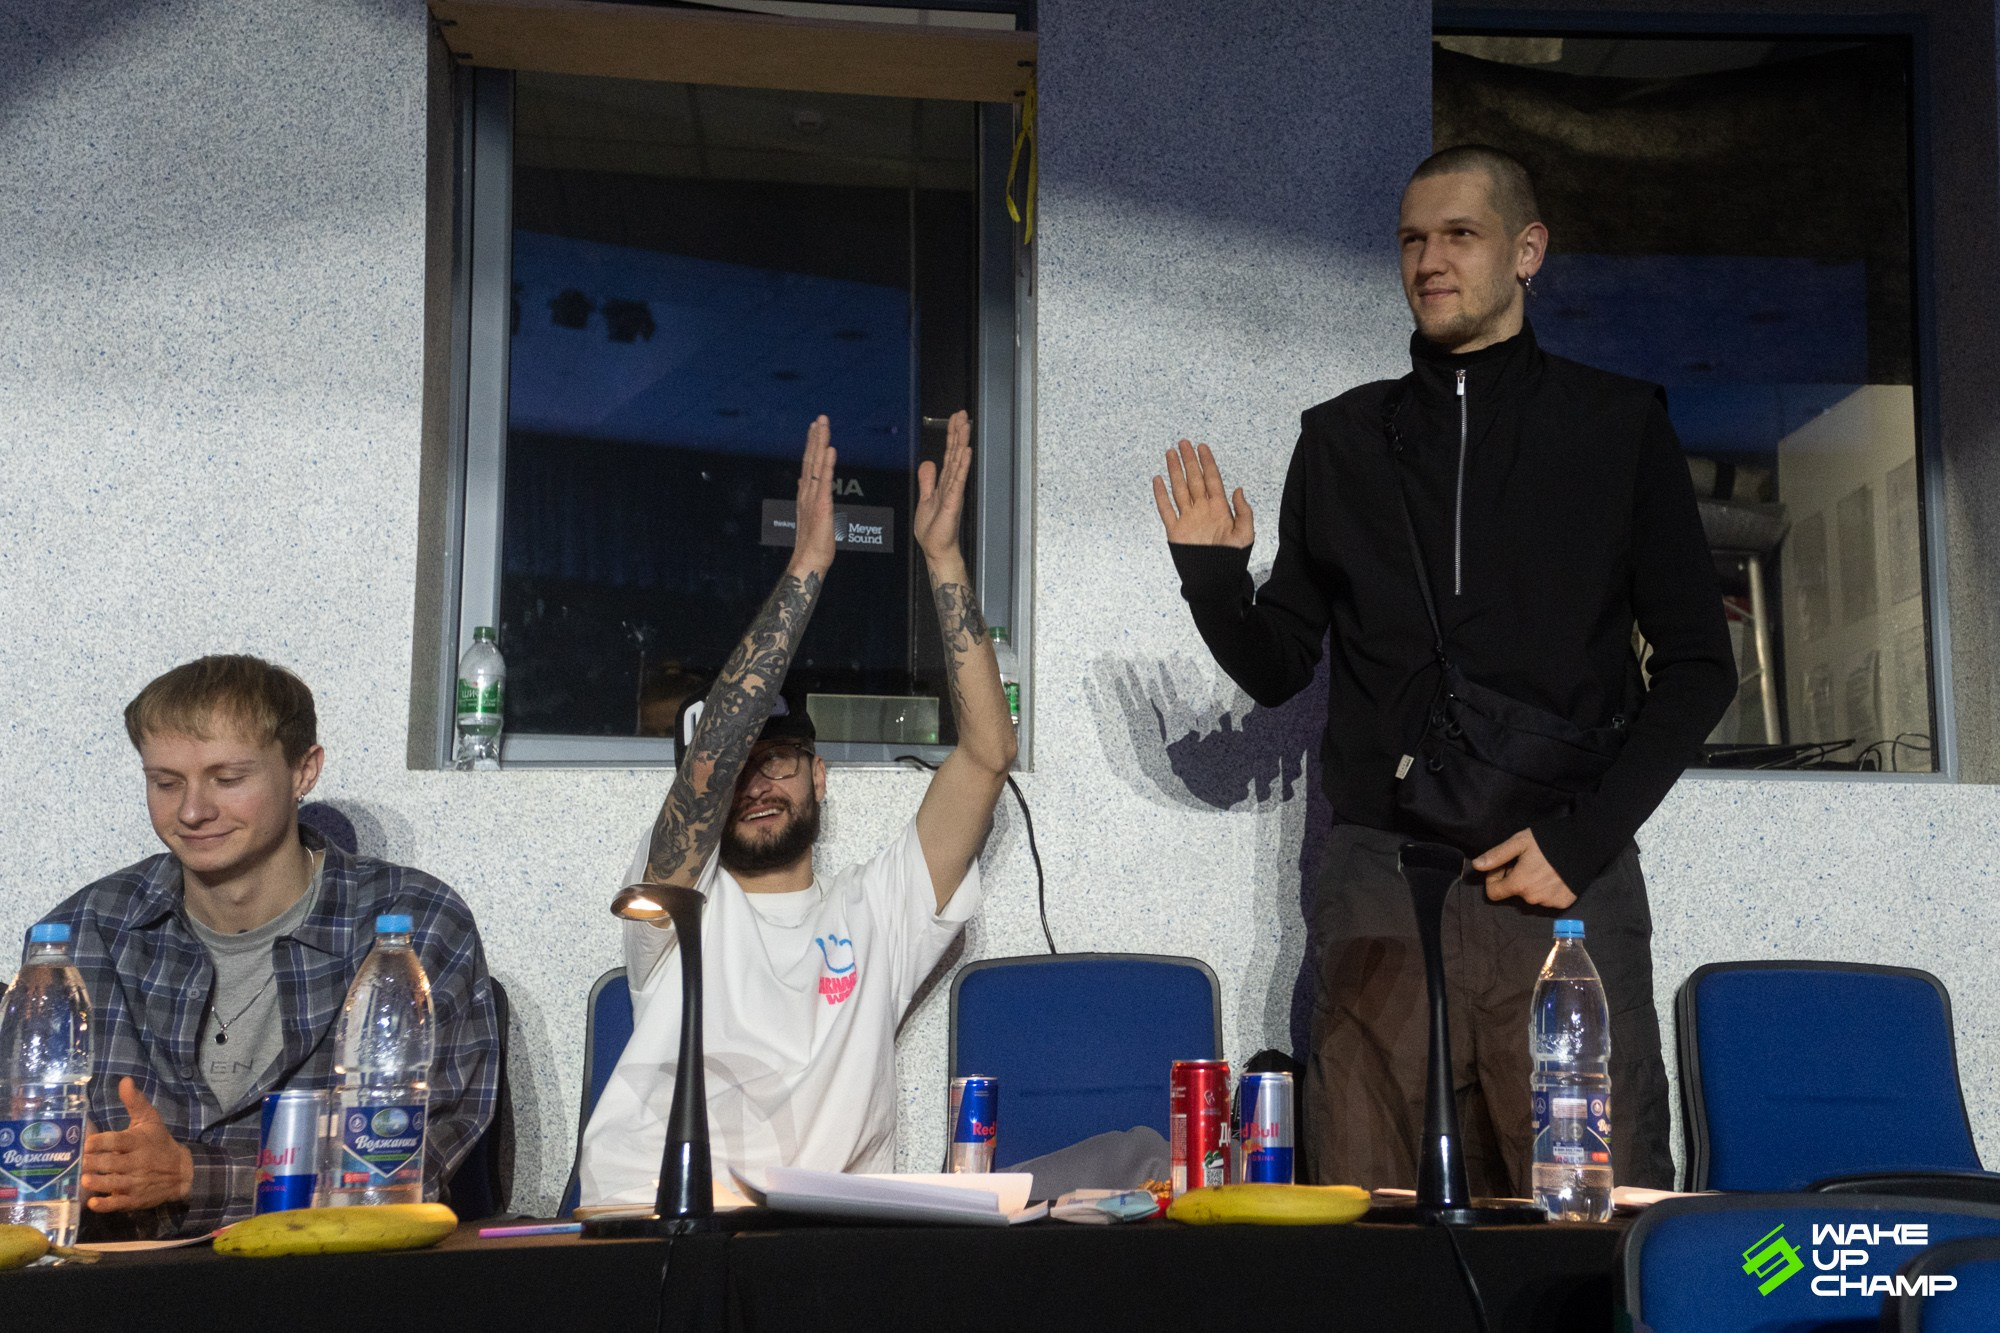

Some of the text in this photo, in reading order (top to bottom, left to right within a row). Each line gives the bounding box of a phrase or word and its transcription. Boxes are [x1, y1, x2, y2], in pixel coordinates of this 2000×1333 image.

[848, 523, 883, 535] Meyer
[848, 533, 883, 545] Sound
[972, 1121, 997, 1136] Red
[1250, 1122, 1279, 1138] Bull
[2, 1149, 72, 1168] Волжанка
[262, 1147, 297, 1166] Bull
